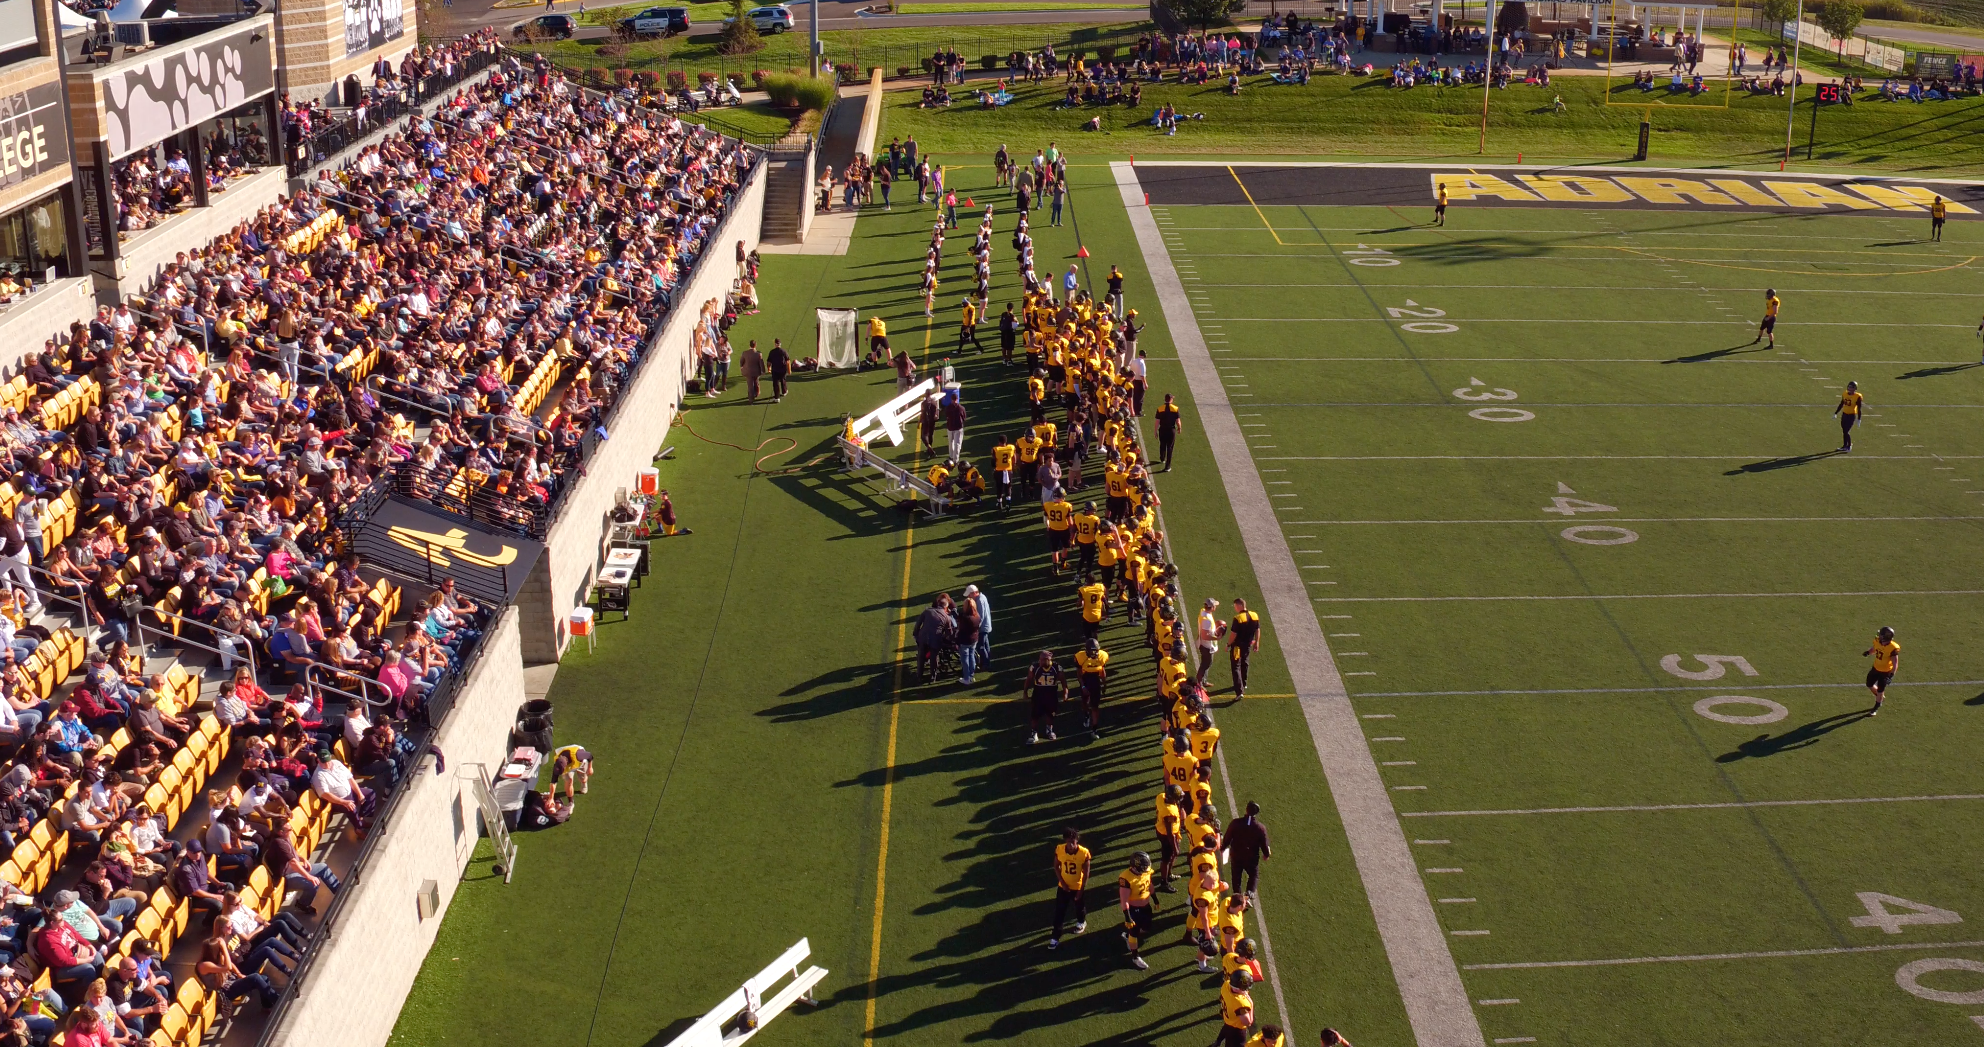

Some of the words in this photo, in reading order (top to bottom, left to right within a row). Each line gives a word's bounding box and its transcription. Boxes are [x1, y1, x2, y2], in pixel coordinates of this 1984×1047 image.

[1923, 57, 1948, 65] FENCE
[1820, 86, 1838, 101] 25
[1641, 127, 1649, 157] ADRIAN
[0, 124, 48, 178] EGE
[1430, 173, 1981, 214] ADRIAN
[1342, 248, 1402, 267] 10
[1386, 307, 1459, 333] 20
[1452, 387, 1536, 422] 30
[1002, 453, 1009, 464] 2
[1111, 480, 1122, 492] 61
[1050, 510, 1063, 522] 93
[1541, 496, 1640, 546] 40
[1079, 522, 1090, 535] 12
[1659, 653, 1789, 725] 50
[1200, 741, 1208, 753] 3
[1171, 766, 1187, 781] 48
[1064, 862, 1077, 875] 12
[1848, 892, 1984, 1005] 40
